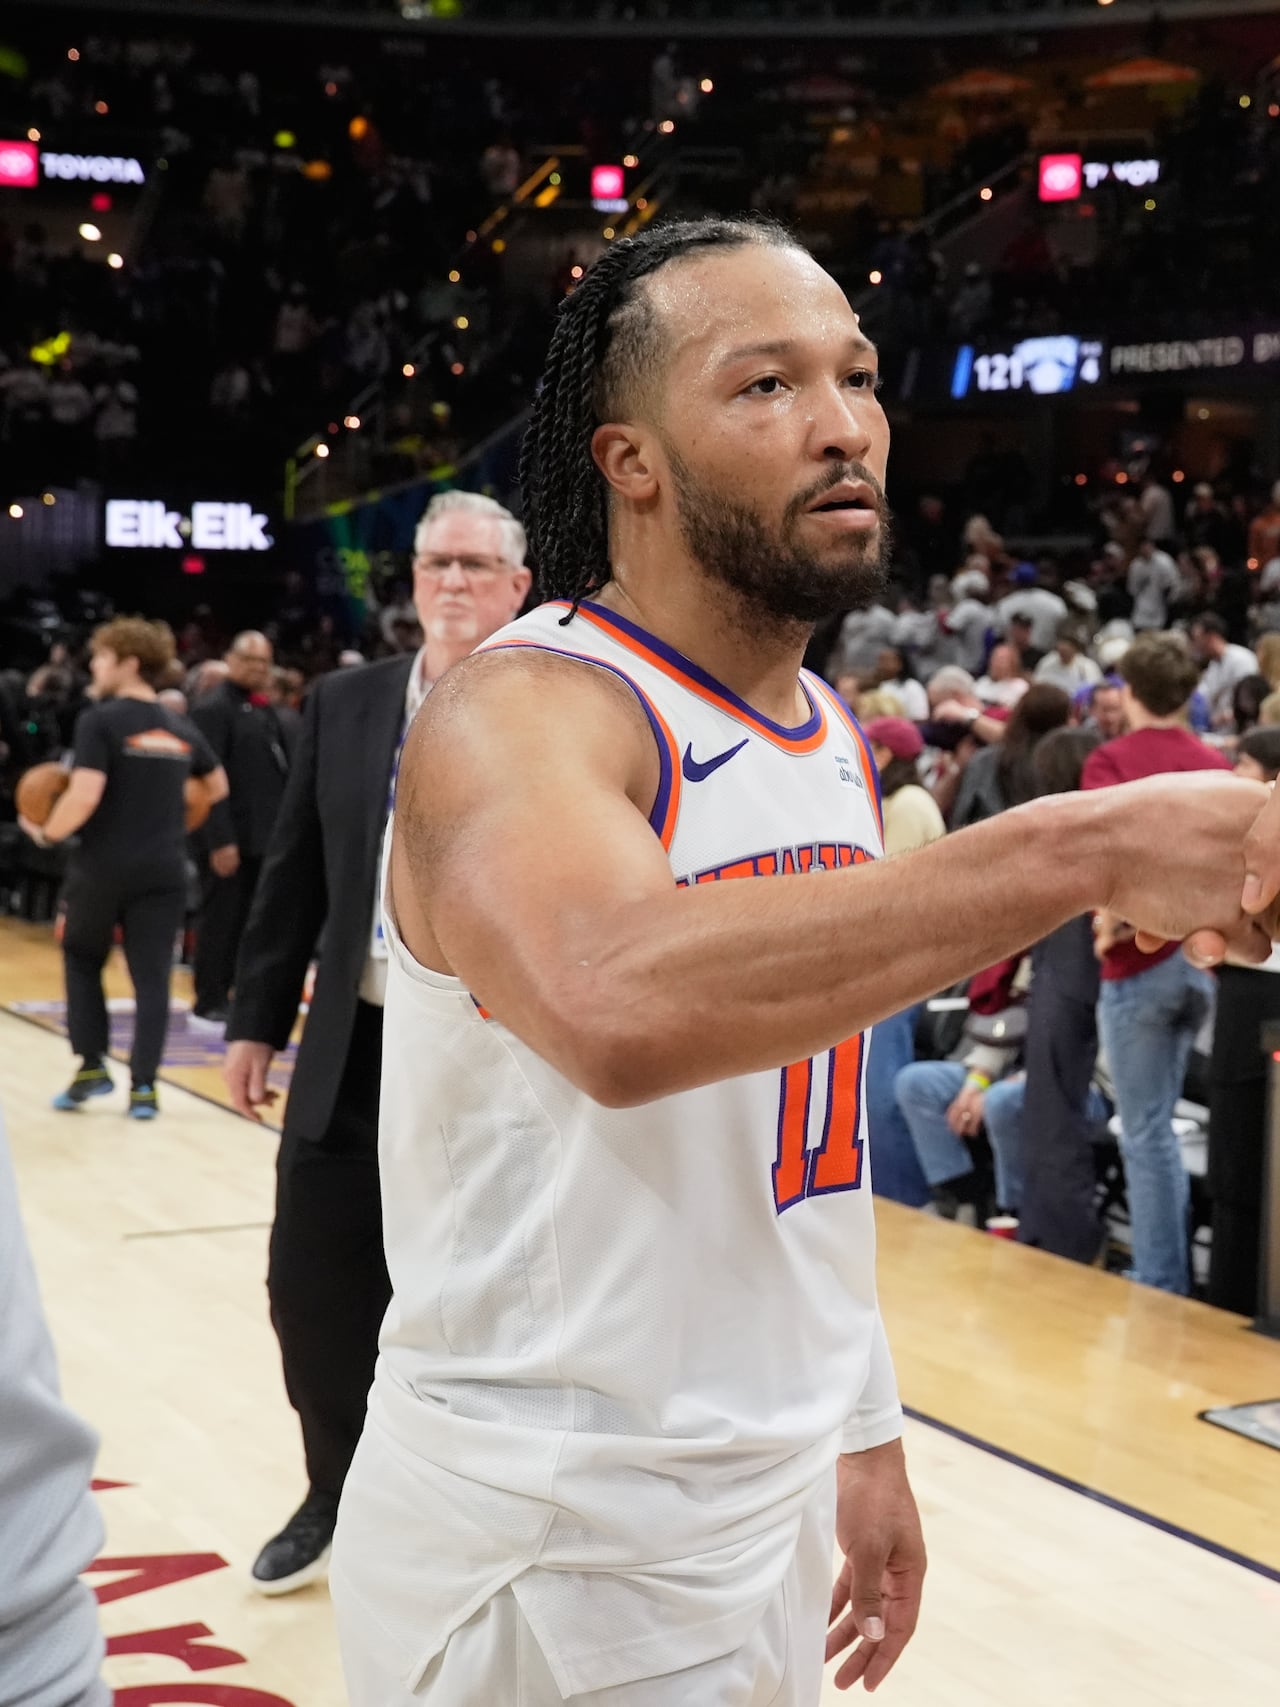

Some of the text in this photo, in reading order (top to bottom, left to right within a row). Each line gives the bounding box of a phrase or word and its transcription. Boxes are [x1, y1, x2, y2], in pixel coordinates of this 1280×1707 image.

[41, 152, 145, 184] TOYOTA
[973, 353, 1024, 392] 121
[1110, 336, 1244, 374] PRESENTED
[105, 499, 184, 549] Elk
[771, 1030, 864, 1216] 11
